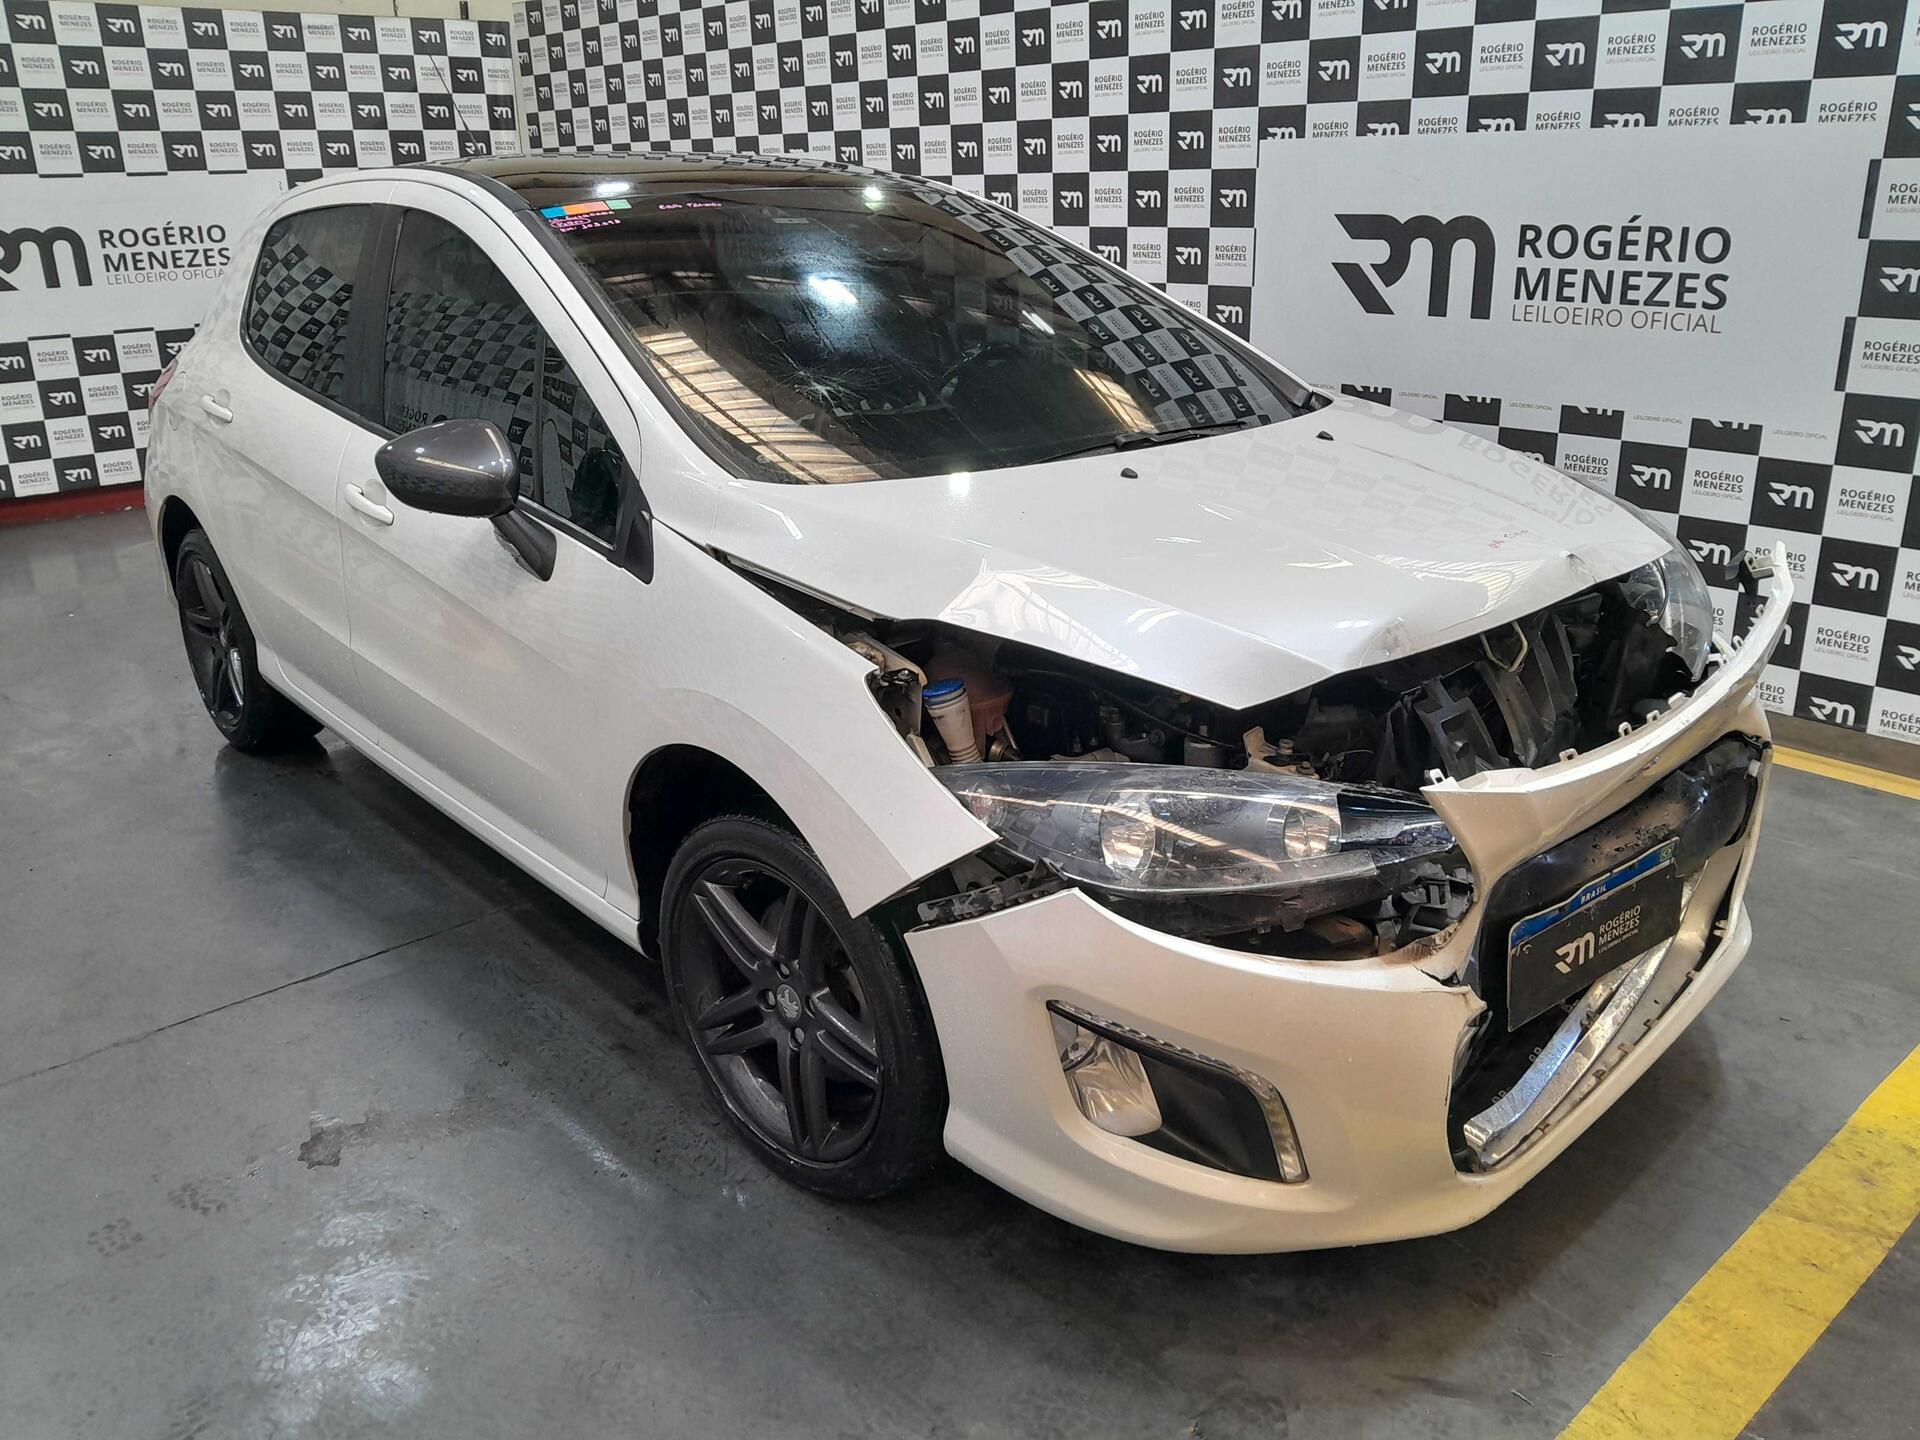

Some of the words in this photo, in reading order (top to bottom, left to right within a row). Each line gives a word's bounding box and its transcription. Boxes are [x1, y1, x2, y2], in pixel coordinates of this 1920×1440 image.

[1221, 10, 1255, 20] MENEZES
[1751, 22, 1808, 36] ROGÉRIO
[1607, 32, 1657, 46] ROGÉRIO
[1750, 33, 1807, 48] MENEZES
[1480, 42, 1524, 54] ROGÉRIO
[1606, 43, 1656, 56] MENEZES
[1367, 51, 1406, 63] ROGÉRIO
[1479, 52, 1523, 64] MENEZES
[1266, 59, 1301, 70] ROGÉRIO
[1367, 61, 1405, 72] MENEZES
[1266, 68, 1300, 79] MENEZES
[1176, 76, 1207, 85] MENEZES
[1668, 105, 1720, 118] ROGÉRIO
[1818, 100, 1879, 113] ROGÉRIO
[1418, 115, 1458, 126] ROGÉRIO
[1536, 110, 1581, 122] ROGÉRIO
[1312, 120, 1348, 130] ROGÉRIO
[1134, 138, 1163, 146] MENEZES
[1218, 134, 1250, 142] MENEZES
[98, 221, 226, 249] ROGÉRIO
[1517, 214, 1732, 264] ROGÉRIO
[103, 247, 231, 273] MENEZES
[1215, 253, 1246, 261] MENEZES
[106, 271, 179, 286] LEILOEIRO
[183, 268, 225, 281] OFICIA
[1513, 266, 1730, 310] MENEZES
[1511, 303, 1623, 328] LEILOEIRO
[1630, 309, 1722, 334] OFICIAL
[1564, 453, 1609, 466] ROGÉRIO
[1563, 462, 1608, 475] MENEZES
[1694, 469, 1744, 484] ROGÉRIO
[1692, 478, 1743, 493] MENEZES
[1839, 488, 1897, 504] ROGÉRIO
[1837, 498, 1895, 514] MENEZES
[1816, 626, 1871, 645] ROGÉRIO
[1815, 636, 1870, 654] MENEZES
[1580, 884, 1607, 905] BRASIL
[1599, 905, 1640, 935] ROGÉRIO
[1598, 916, 1640, 946] MENEZES
